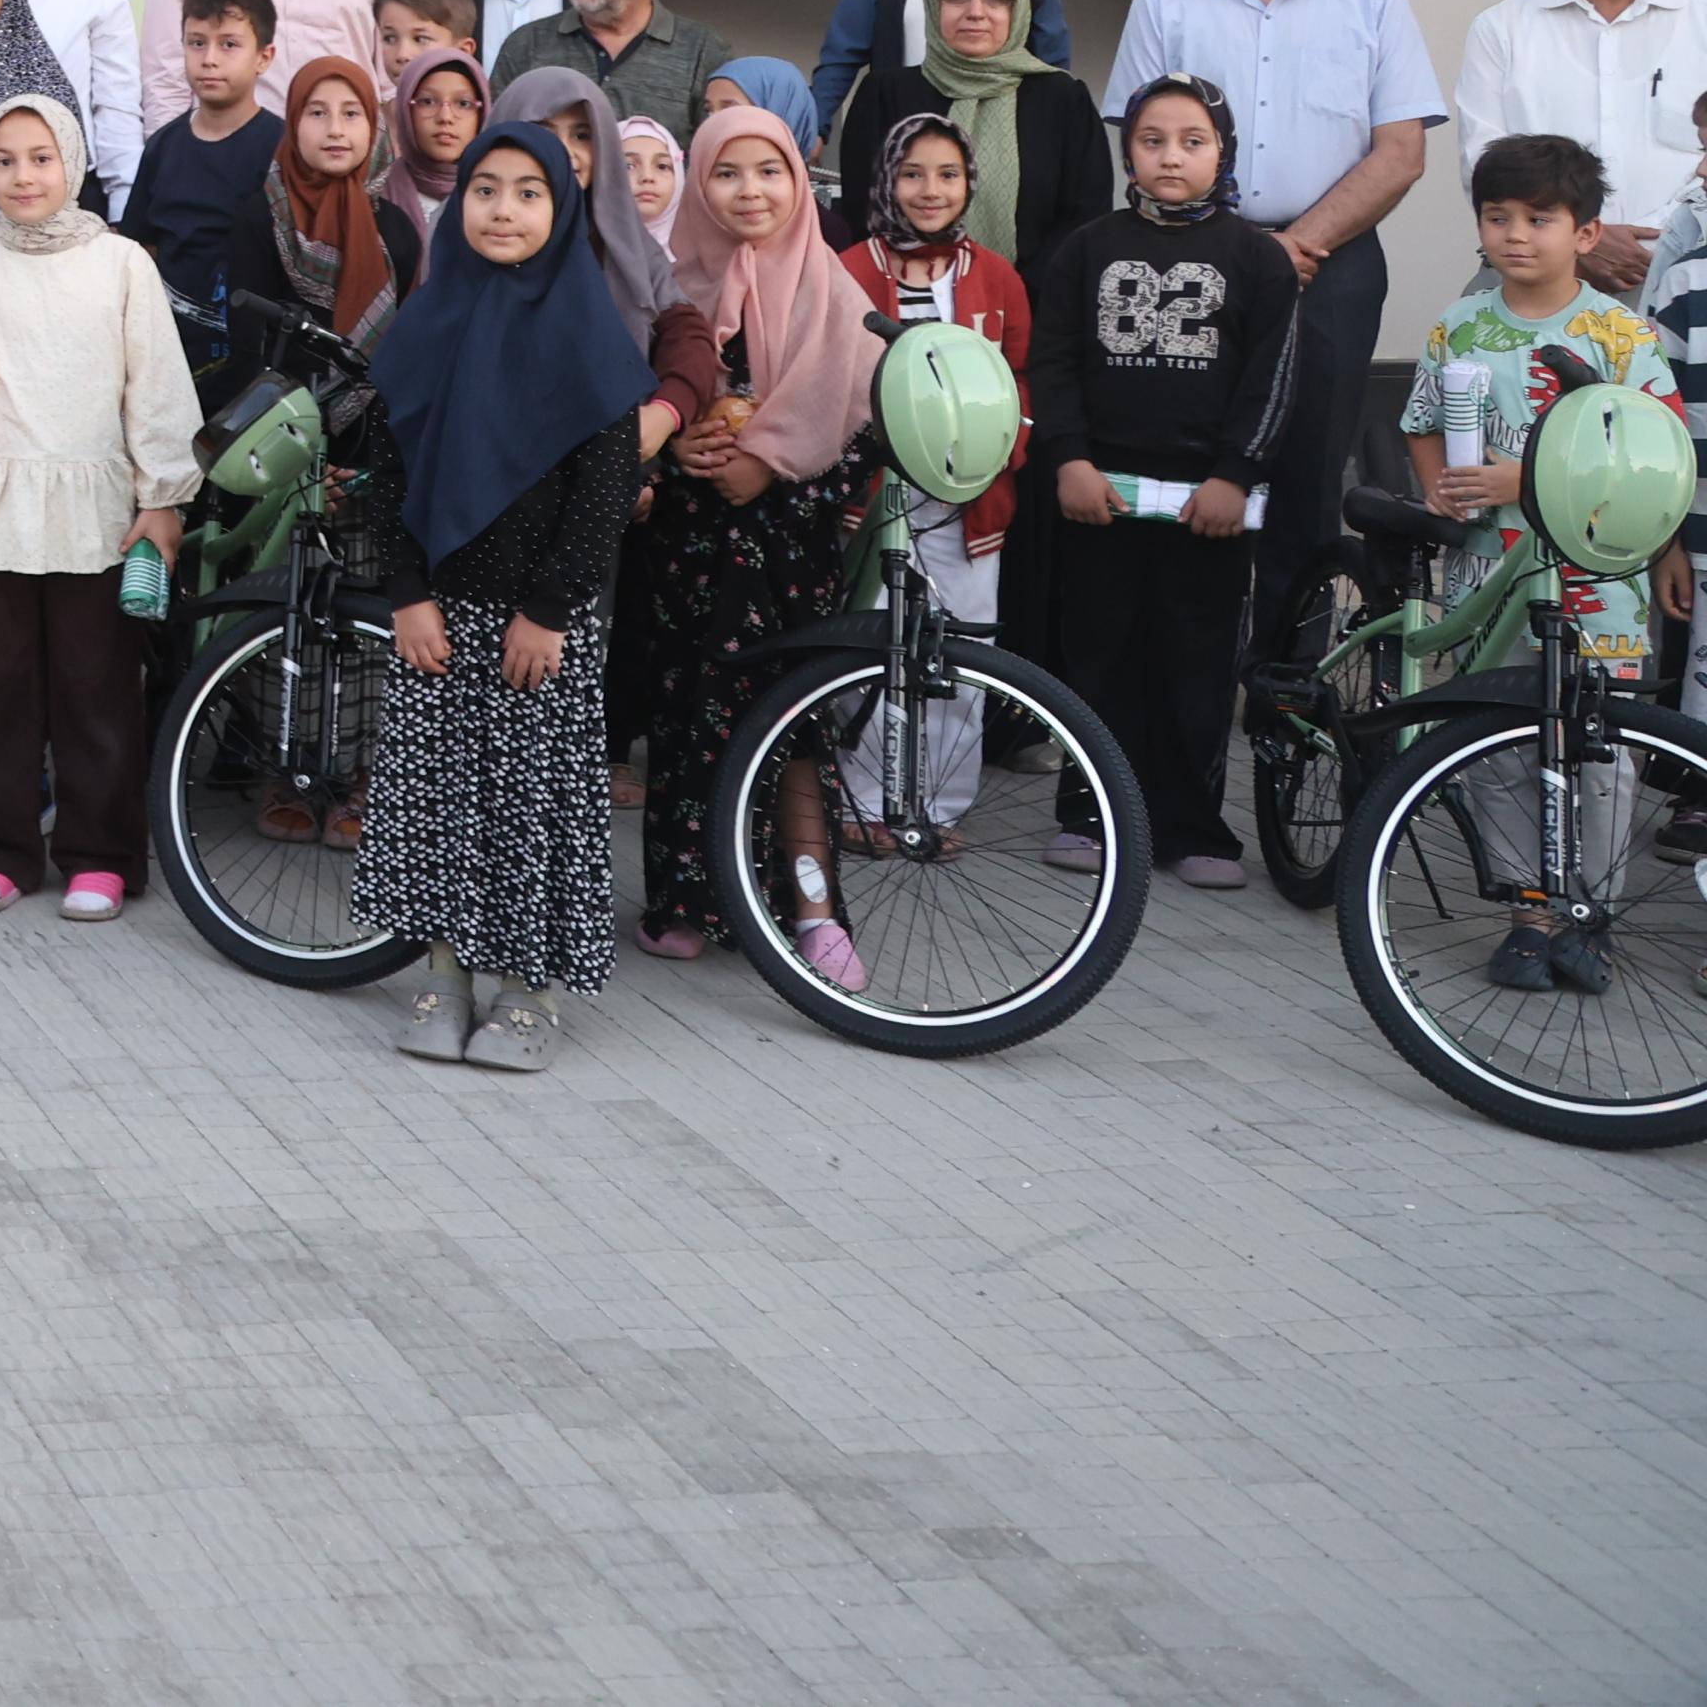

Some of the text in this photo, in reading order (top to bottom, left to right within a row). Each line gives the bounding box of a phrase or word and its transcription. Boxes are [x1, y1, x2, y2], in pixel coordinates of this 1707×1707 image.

[1097, 260, 1226, 359] 82
[1107, 356, 1208, 370] DREAM TEAM
